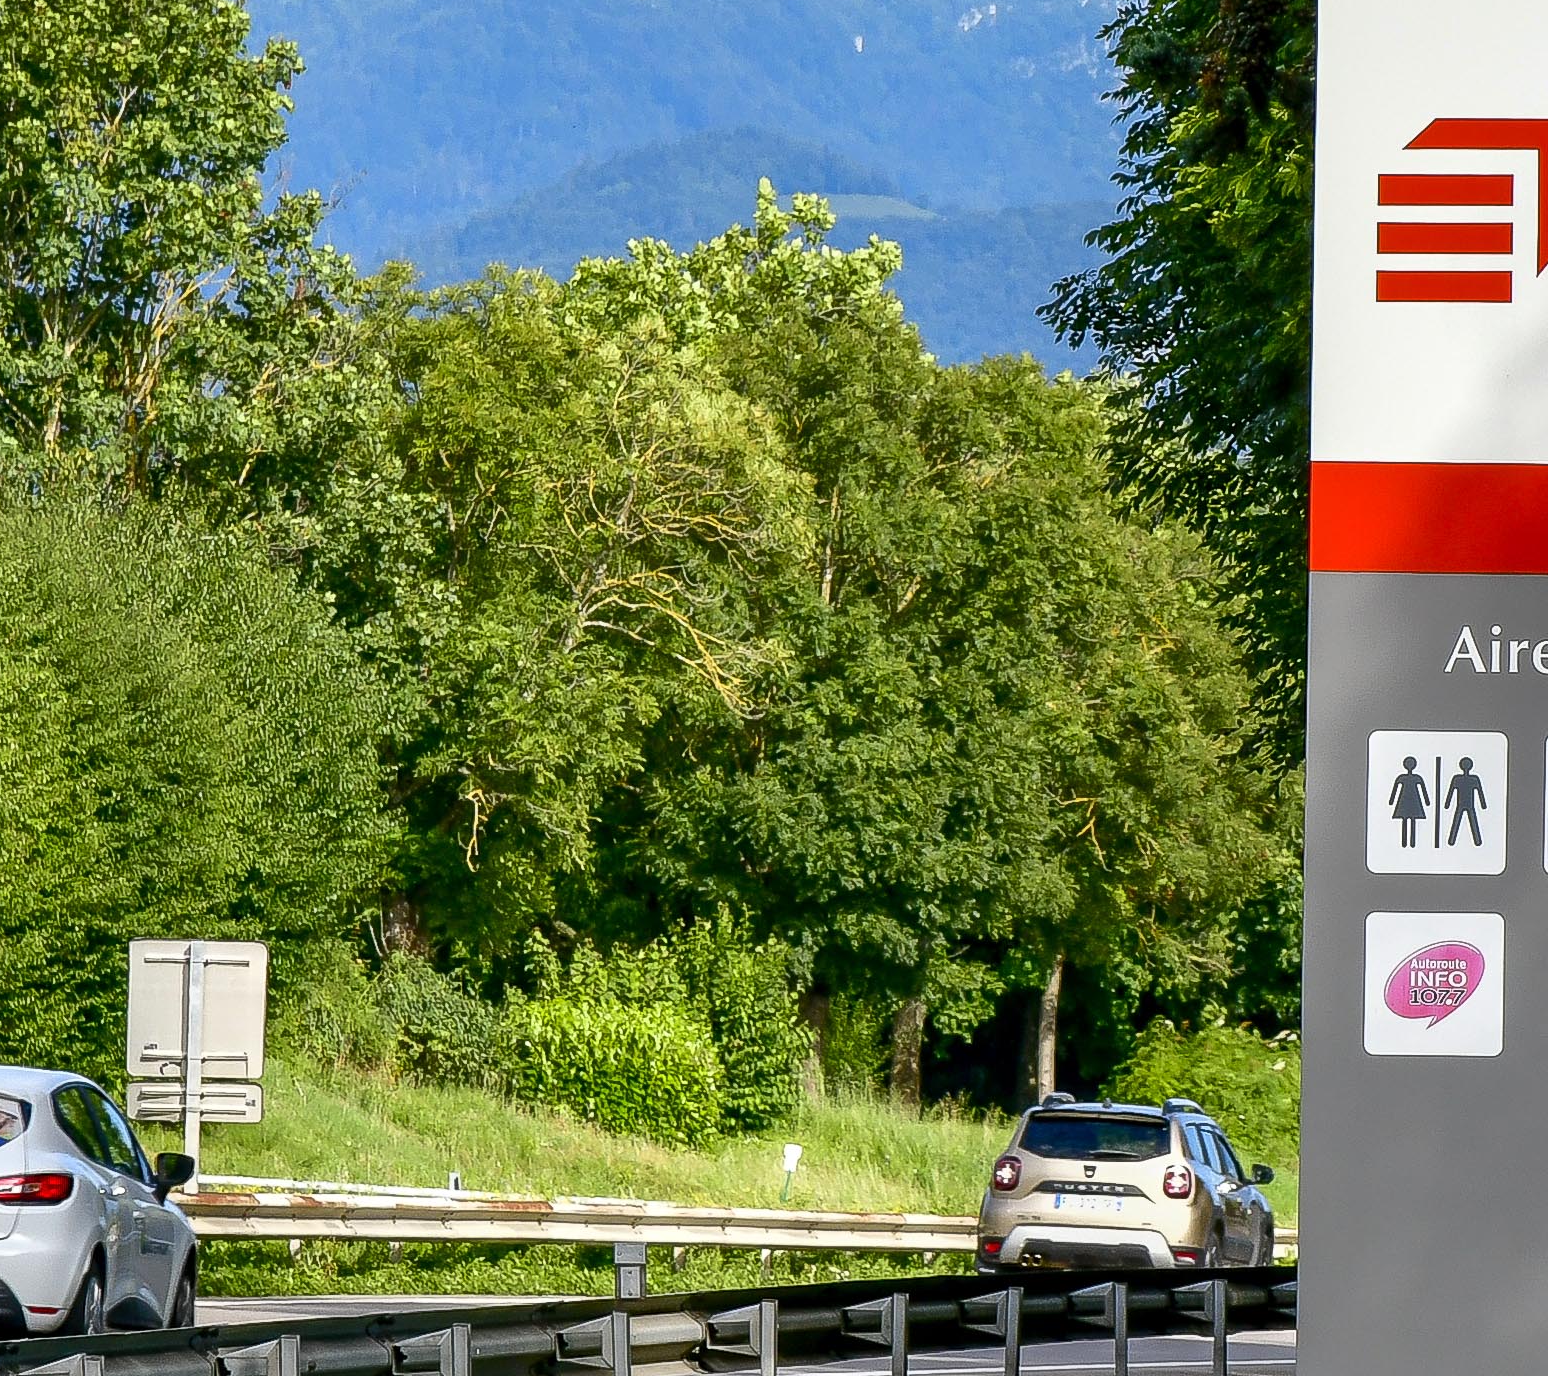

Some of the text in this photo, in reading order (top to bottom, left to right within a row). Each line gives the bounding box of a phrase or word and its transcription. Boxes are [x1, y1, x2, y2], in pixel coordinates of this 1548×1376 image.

[1410, 958, 1466, 969] Autoroute
[1410, 970, 1467, 987] INFO
[1410, 989, 1465, 1005] 107.7
